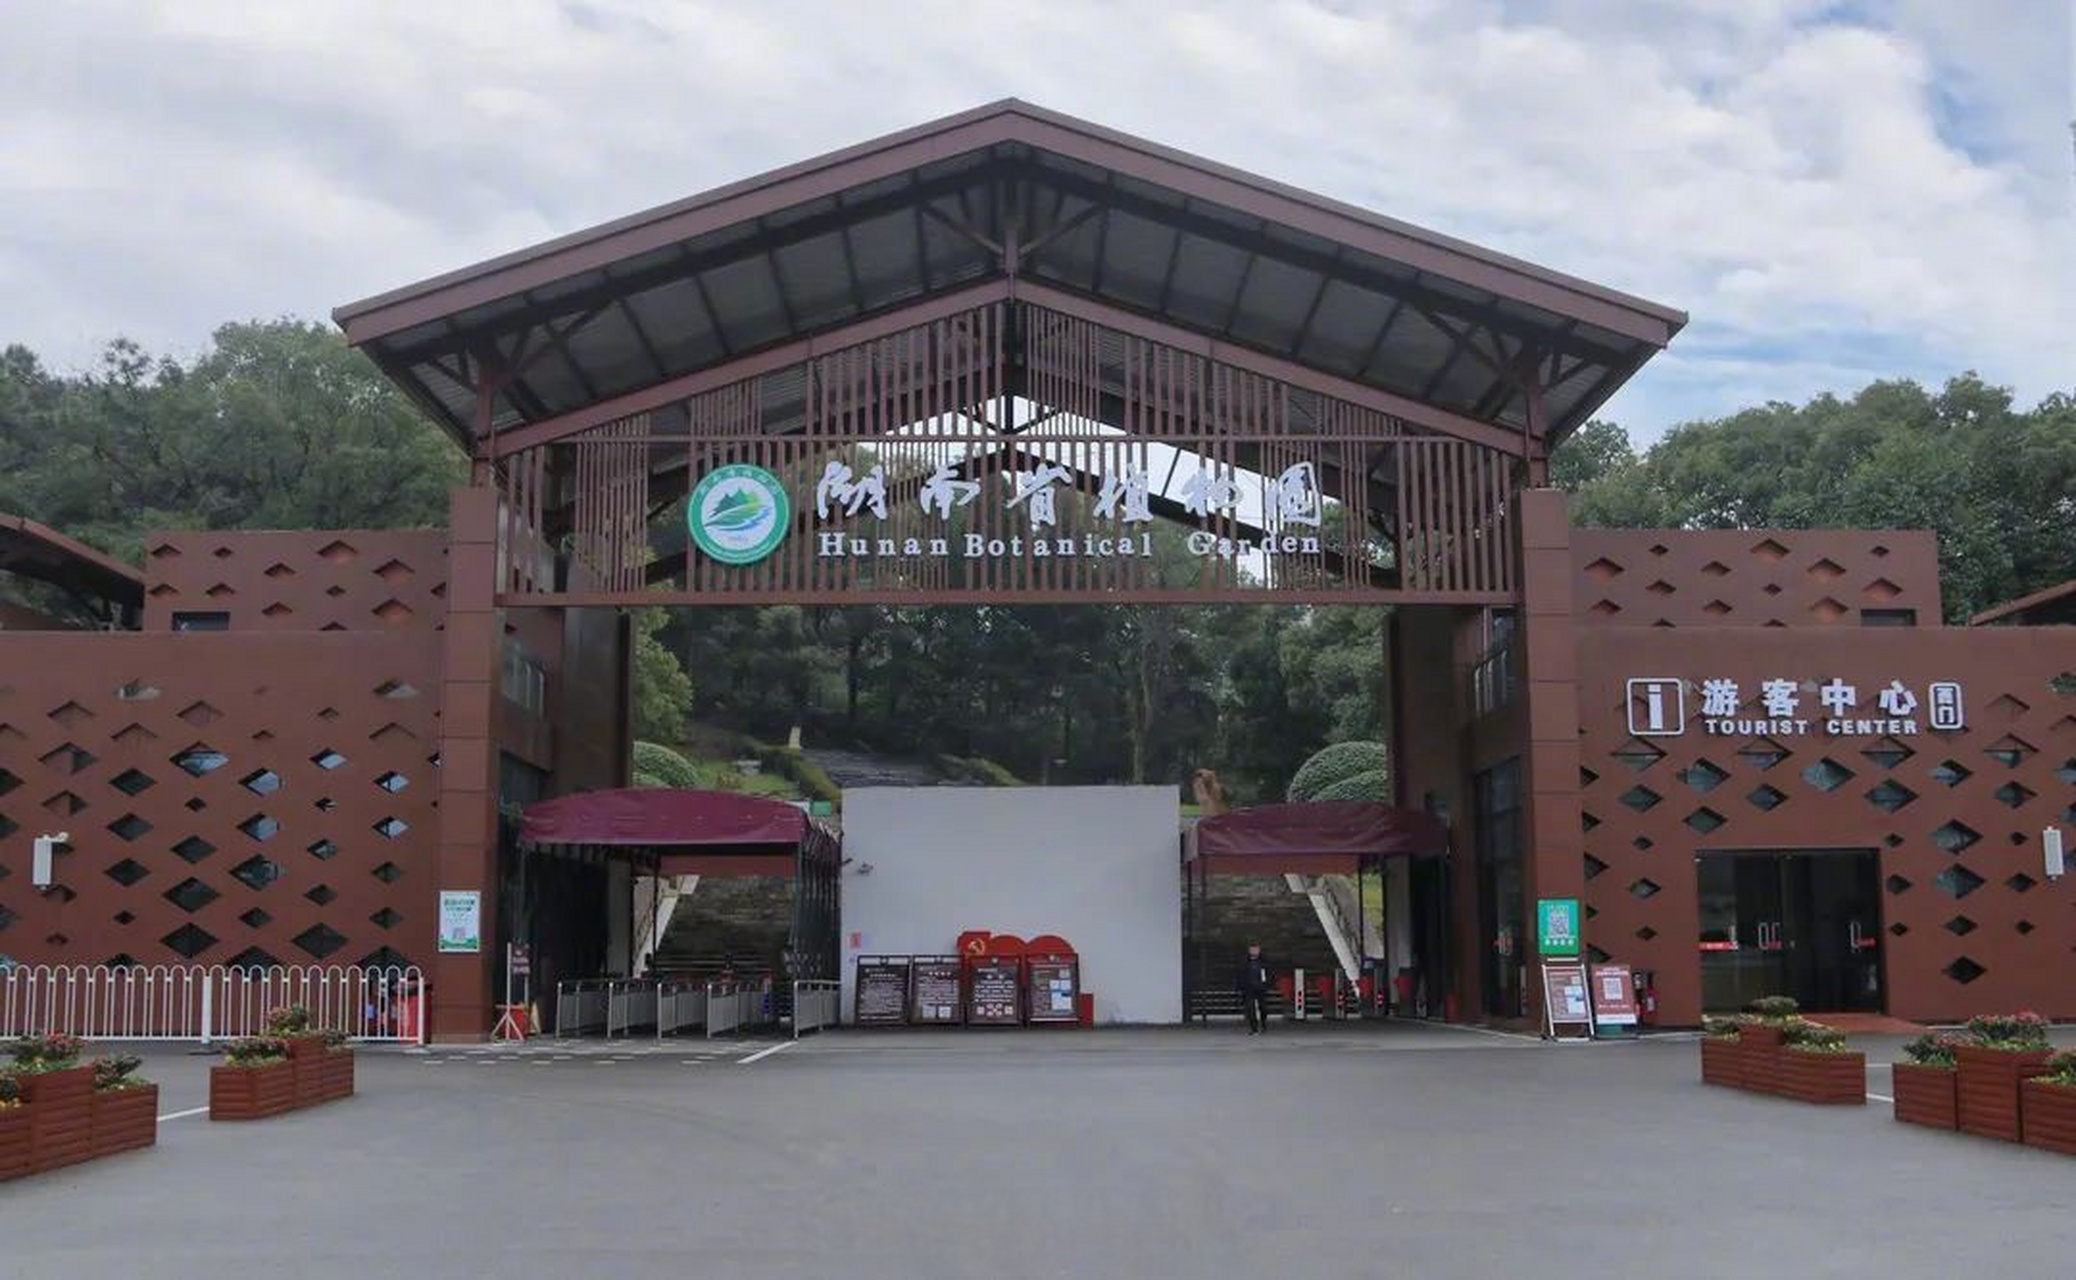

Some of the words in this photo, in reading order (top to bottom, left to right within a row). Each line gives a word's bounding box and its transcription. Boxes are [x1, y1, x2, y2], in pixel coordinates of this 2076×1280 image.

[818, 532, 949, 557] Hunan
[964, 532, 1152, 557] Botanical
[1187, 531, 1320, 557] Garden
[1702, 678, 1917, 716] 游客中心
[1705, 719, 1808, 735] TOURIST
[1827, 719, 1918, 735] CENTER
